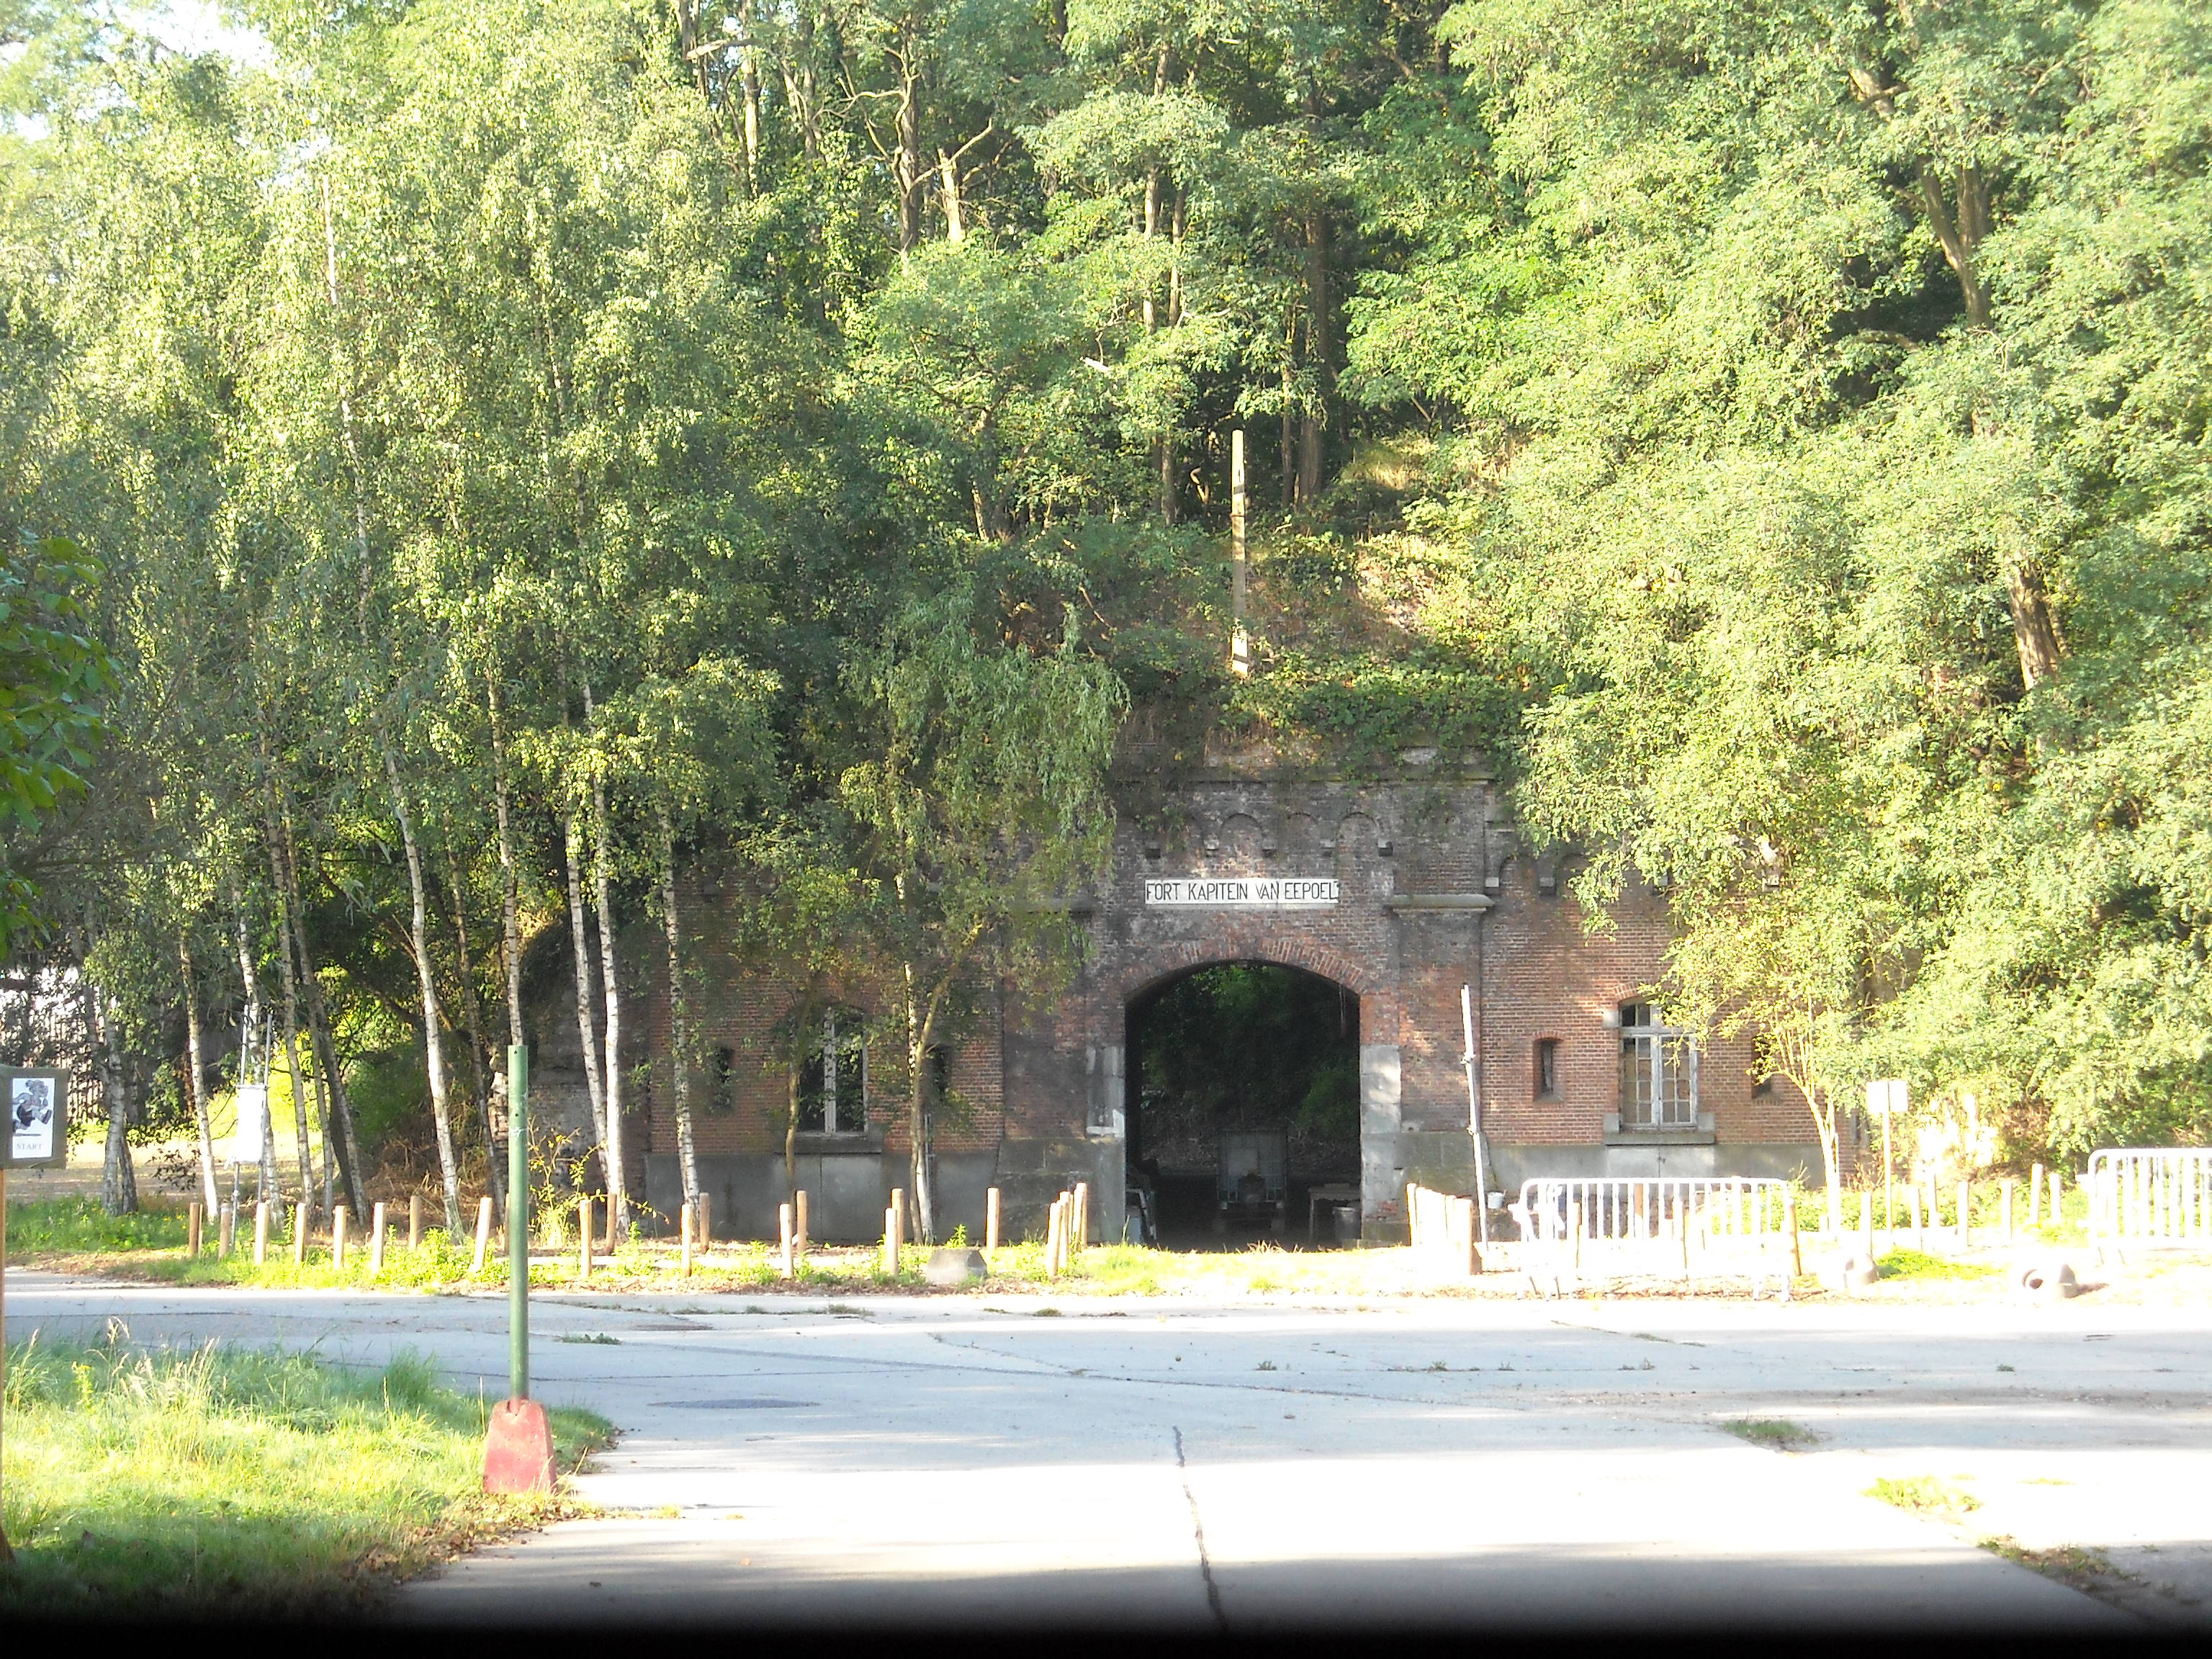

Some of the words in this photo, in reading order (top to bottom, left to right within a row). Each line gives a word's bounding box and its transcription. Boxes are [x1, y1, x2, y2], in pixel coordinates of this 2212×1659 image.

[1146, 883, 1181, 900] FORT
[1188, 883, 1248, 900] KAPITEIN
[1255, 881, 1279, 899] VAN
